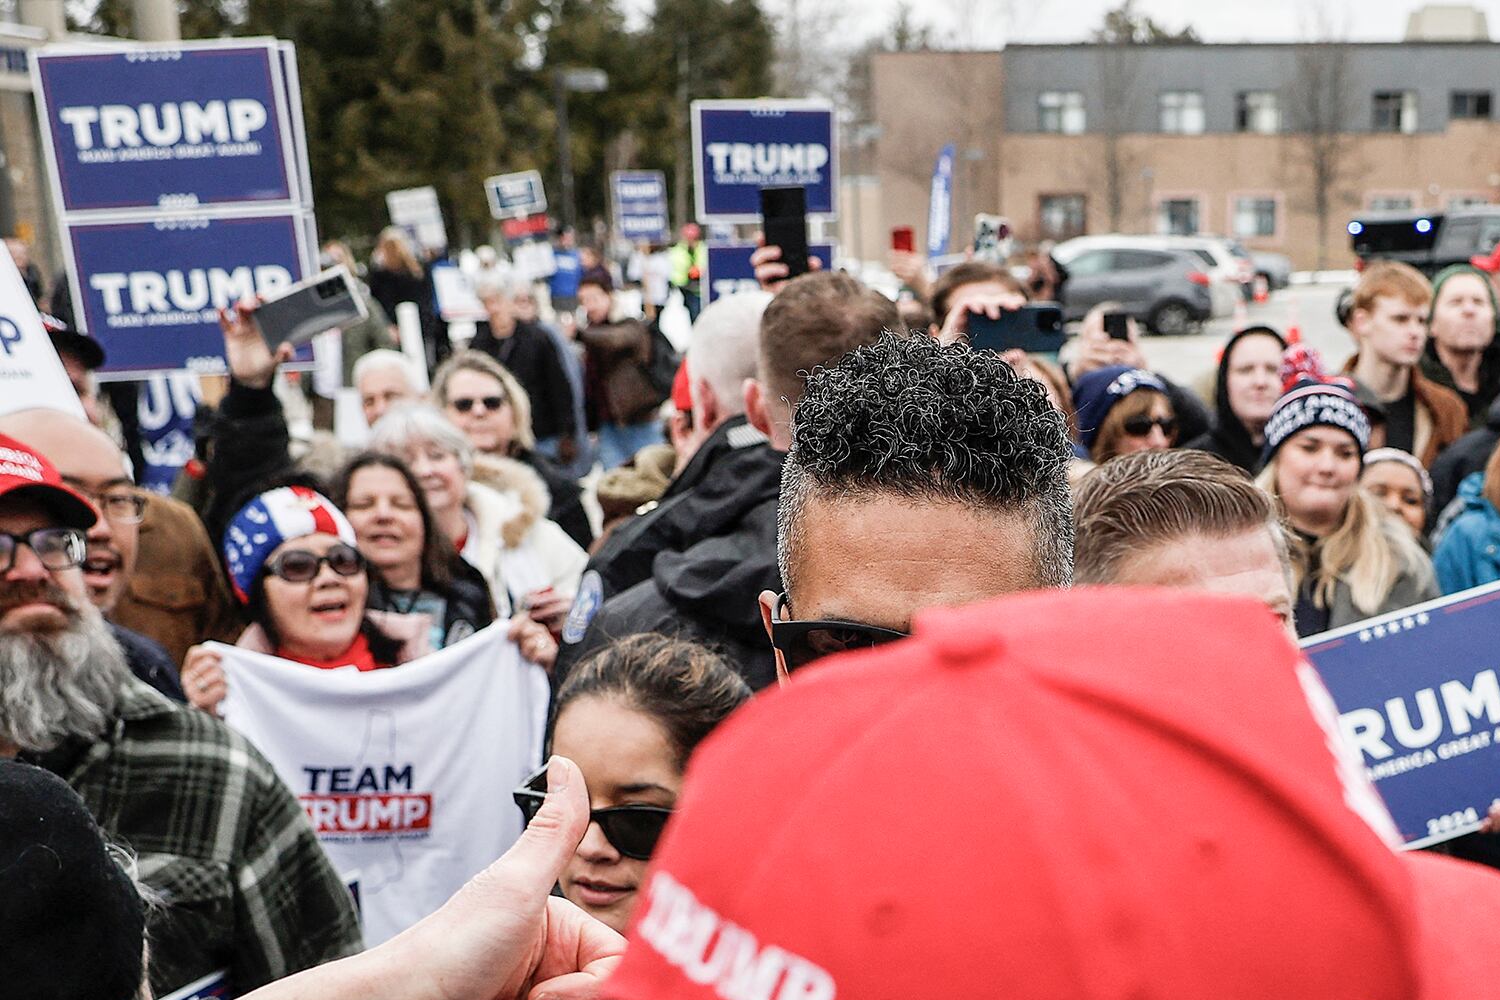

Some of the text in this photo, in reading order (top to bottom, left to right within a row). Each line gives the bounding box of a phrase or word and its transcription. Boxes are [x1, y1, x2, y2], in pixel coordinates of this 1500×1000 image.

[59, 98, 268, 150] TRUMP
[706, 142, 829, 174] TRUMP
[89, 264, 293, 315] TRUMP
[1437, 730, 1492, 760] GREAT
[303, 764, 413, 793] TEAM
